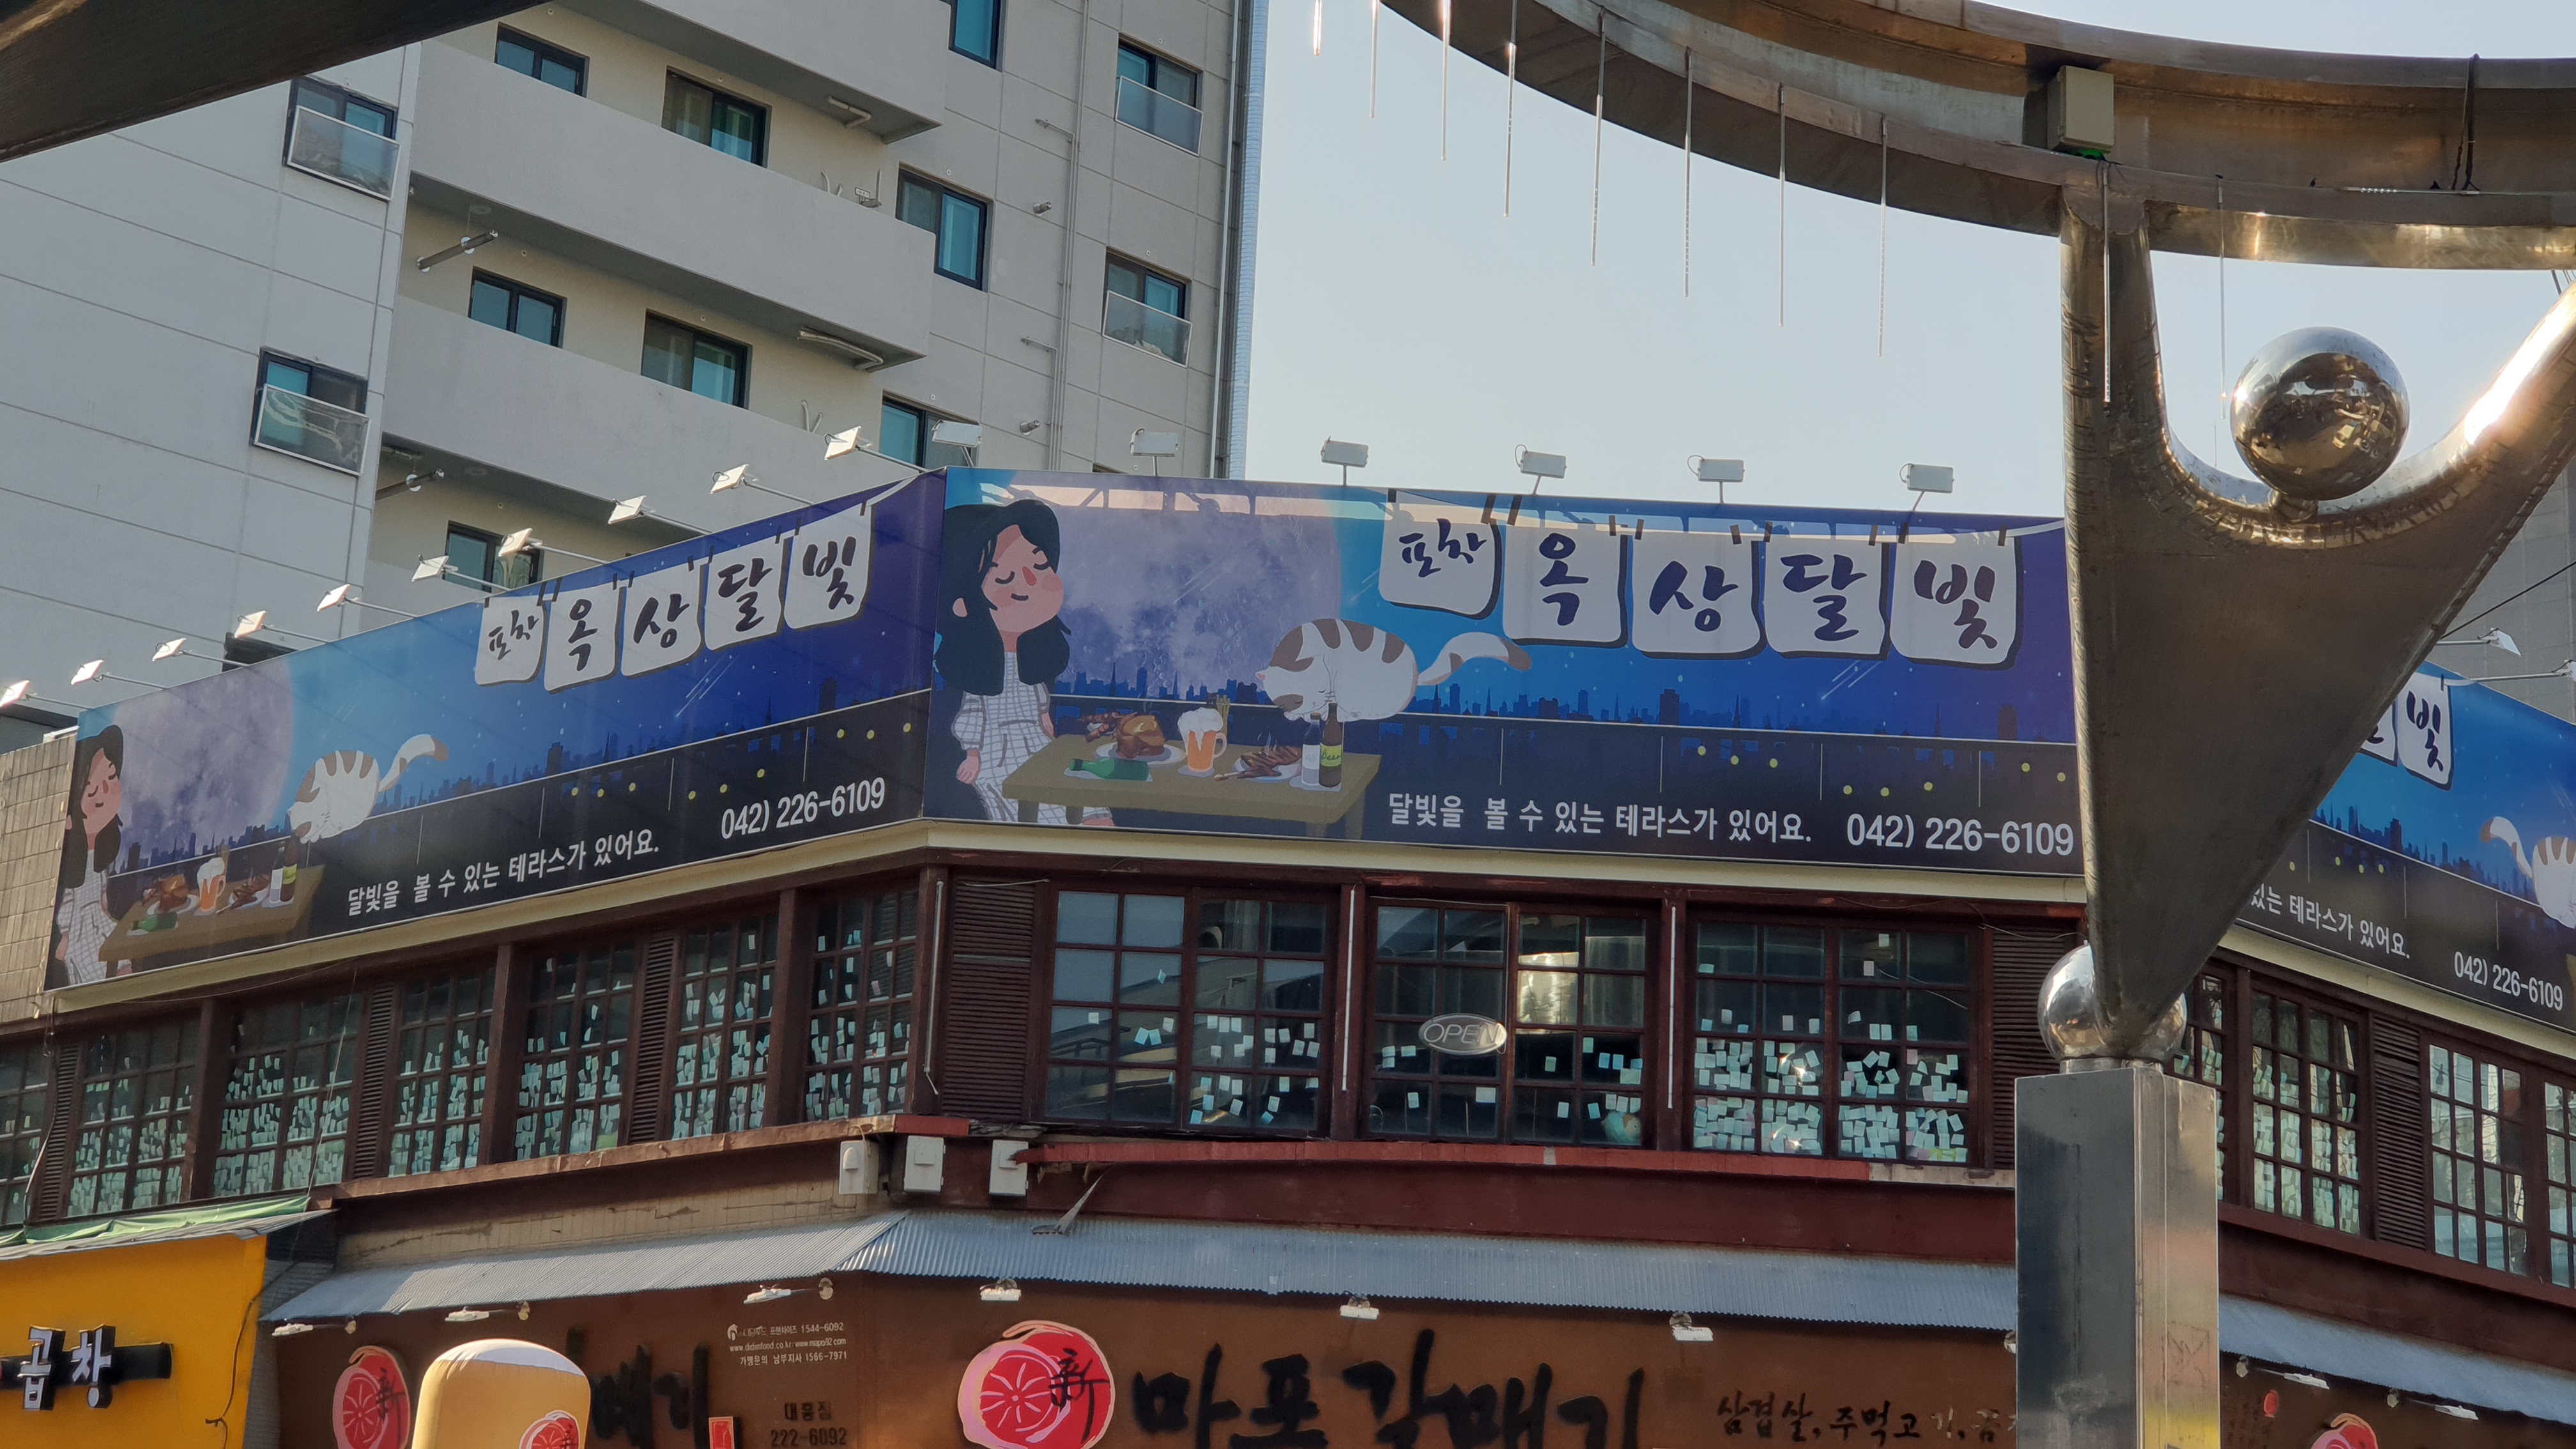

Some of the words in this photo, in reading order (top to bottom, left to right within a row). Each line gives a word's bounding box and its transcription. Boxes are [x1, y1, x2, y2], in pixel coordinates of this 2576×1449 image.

[568, 537, 856, 671] 옥상달빛
[1538, 532, 1998, 650] 옥상달빛
[721, 800, 769, 839] 042)
[776, 777, 885, 828] 226-6109
[1388, 792, 1464, 828] 달빛을
[1483, 797, 1508, 831] 볼
[1518, 799, 1544, 832] 수
[1554, 801, 1605, 834] 있는
[1616, 804, 1718, 840] 테라스가
[1728, 809, 1812, 843] 있어요.
[1846, 813, 1915, 848] 042)
[1924, 817, 2074, 855] 226-6109
[347, 880, 400, 916] 달빛을
[413, 873, 431, 903] 볼
[438, 870, 456, 898] 수
[463, 861, 501, 894] 있는
[508, 840, 586, 884] 테라스가
[594, 828, 659, 868] 있어요.
[2289, 894, 2354, 941] 테라스가
[2360, 919, 2411, 959] 있어요.
[2454, 951, 2488, 986] 042)
[2493, 964, 2563, 1011] 226-6109
[1423, 1023, 1500, 1043] OPEN
[801, 1322, 844, 1334] 1544-6092
[17, 1323, 115, 1411] 곱창
[740, 1354, 768, 1367] 가맹문의
[773, 1353, 802, 1365] 남부지사
[805, 1351, 847, 1362] 1566-7971
[770, 1427, 847, 1448] 222-6092
